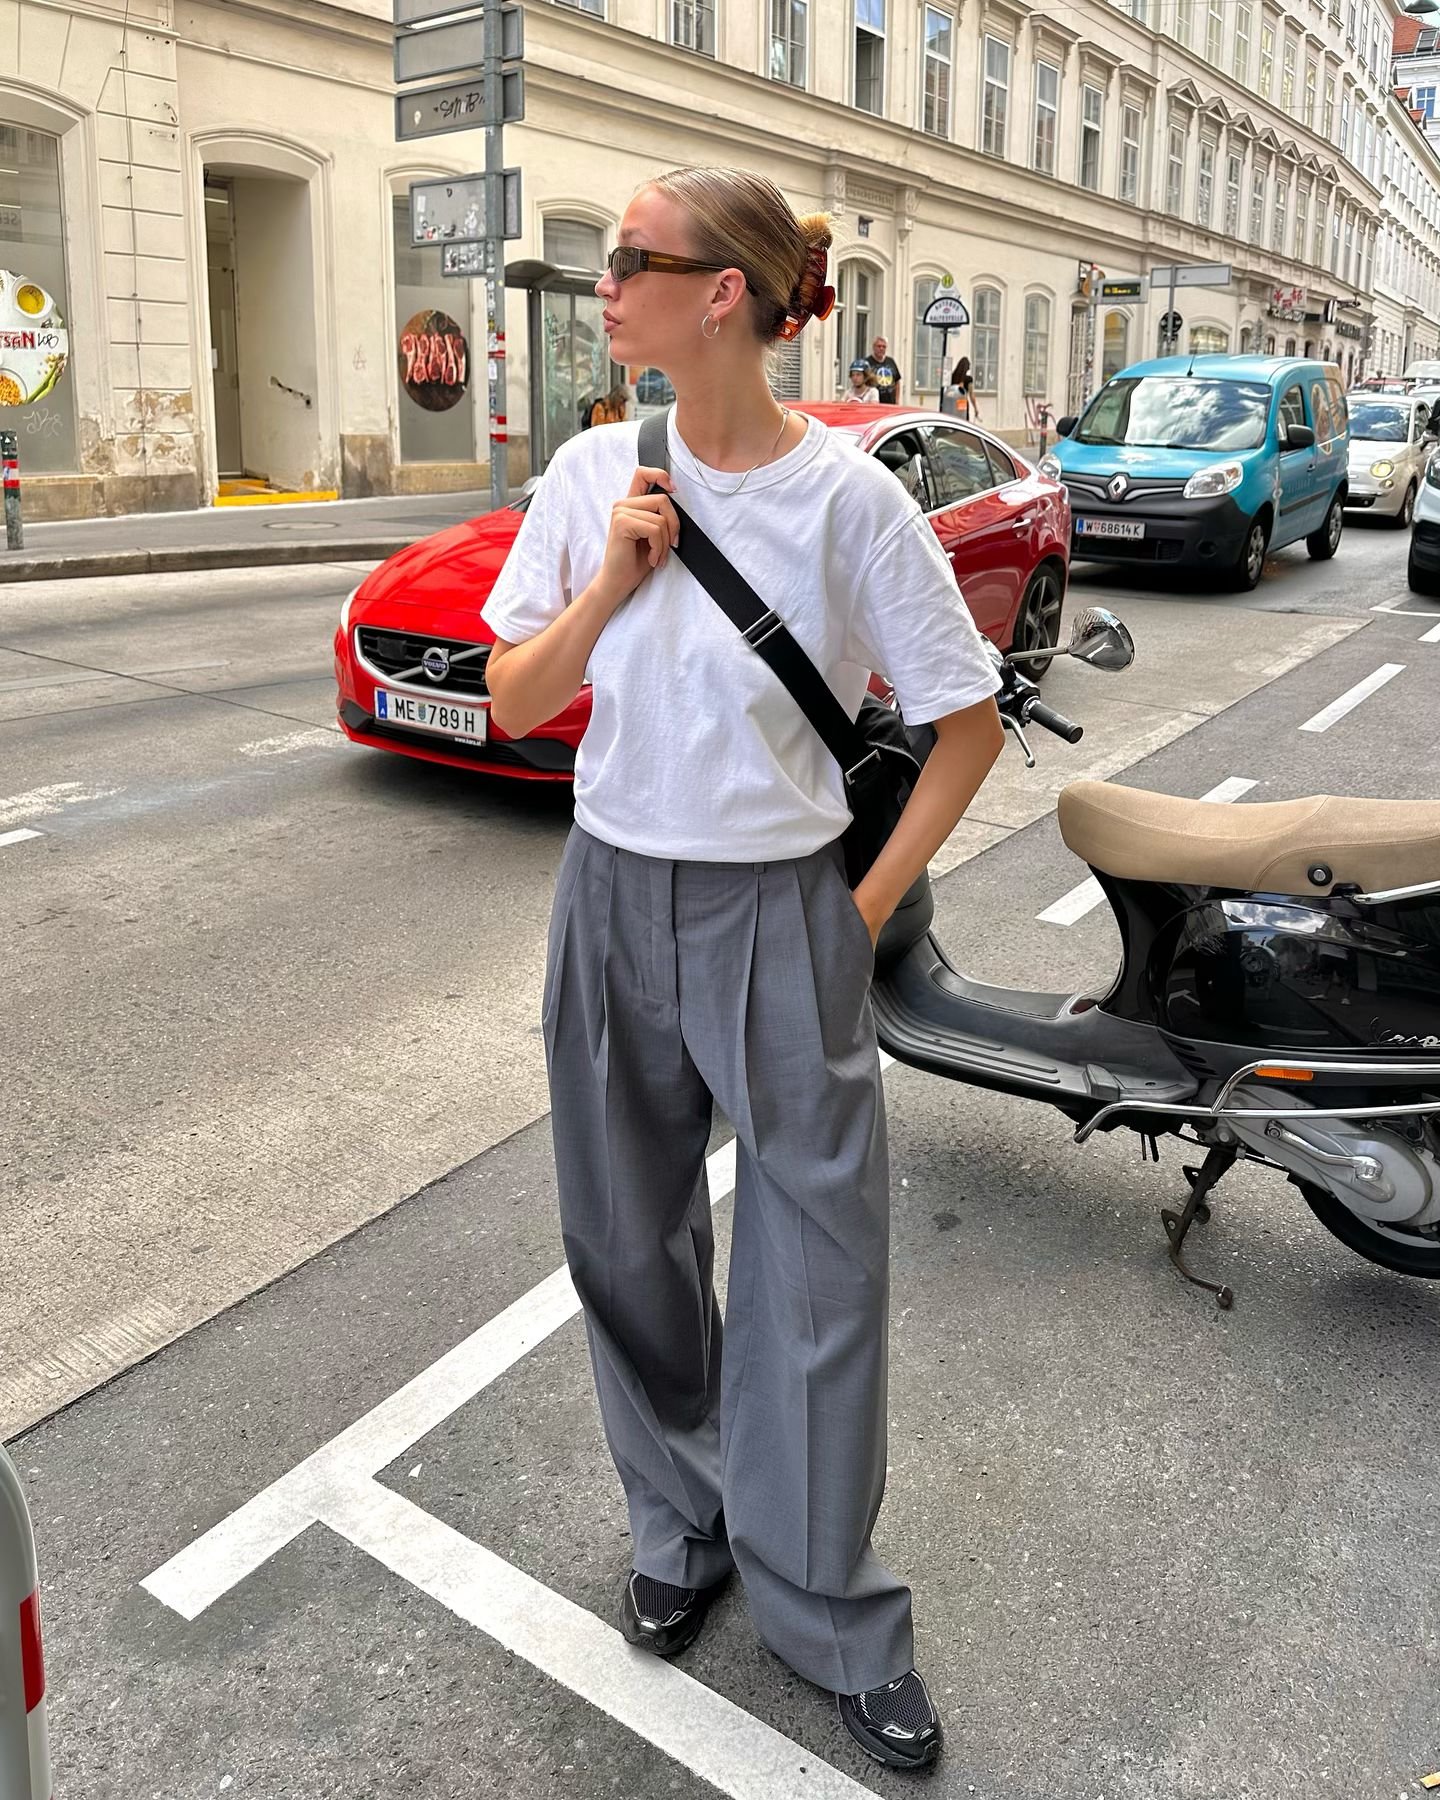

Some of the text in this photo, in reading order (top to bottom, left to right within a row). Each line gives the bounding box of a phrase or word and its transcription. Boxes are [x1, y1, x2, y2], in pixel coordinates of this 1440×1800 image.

[423, 660, 446, 669] VOLVO
[395, 698, 415, 721] ME
[1368, 1016, 1440, 1048] Vesp
